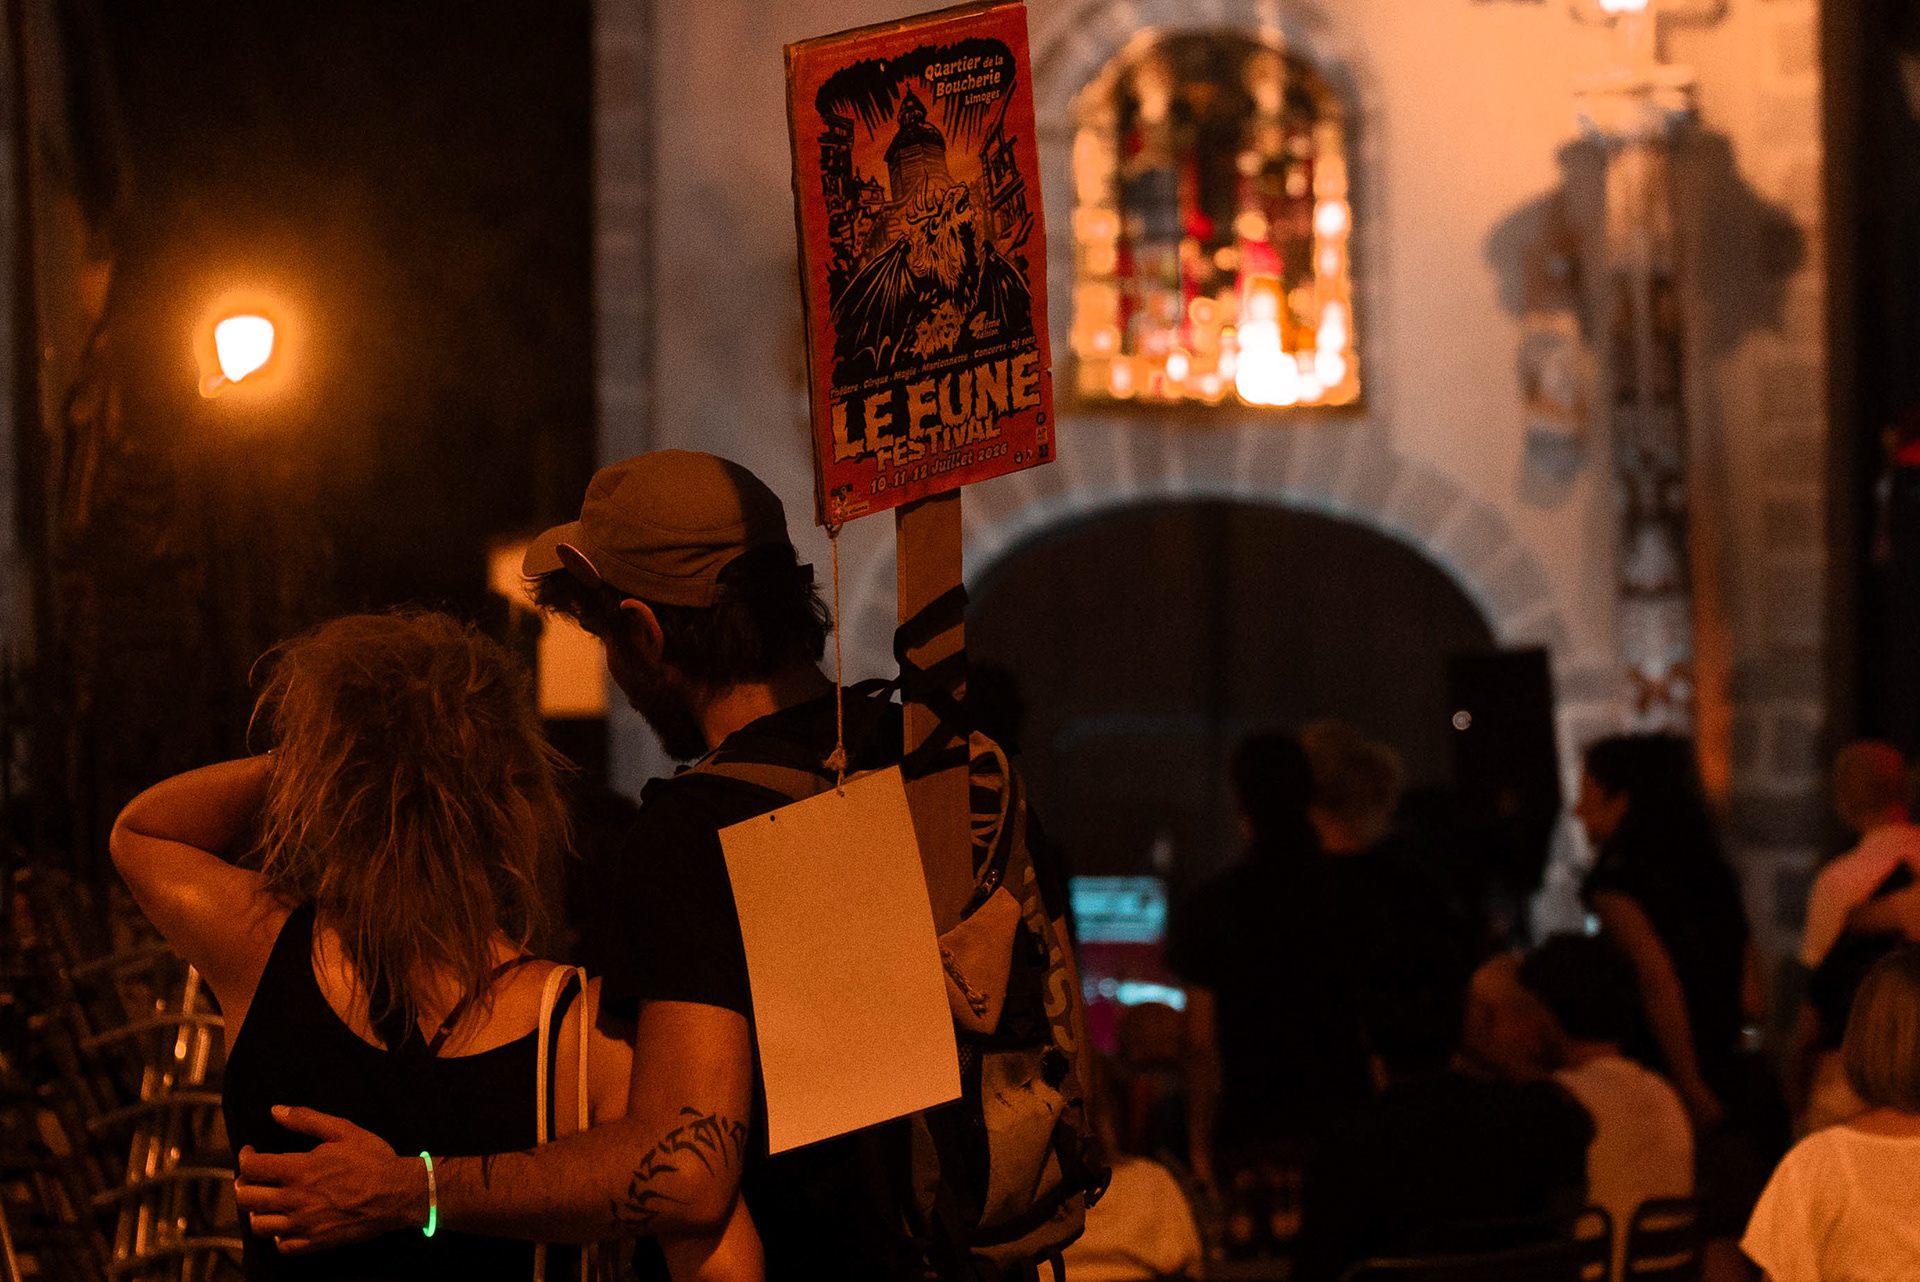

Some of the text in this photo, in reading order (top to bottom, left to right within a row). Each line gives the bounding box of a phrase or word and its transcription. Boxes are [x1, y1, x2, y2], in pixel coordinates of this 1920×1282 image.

[983, 56, 993, 69] de
[995, 54, 1004, 67] la
[936, 69, 1001, 97] Boucherie
[965, 90, 1001, 105] Limoges
[863, 376, 889, 391] Cirque
[894, 366, 917, 382] Magie
[922, 353, 968, 372] Marionnette
[973, 343, 1006, 359] Concerts
[831, 389, 893, 463] LE
[876, 410, 1002, 472] FESTIVAL
[931, 451, 974, 475] Juillet
[978, 442, 1008, 463] 2026
